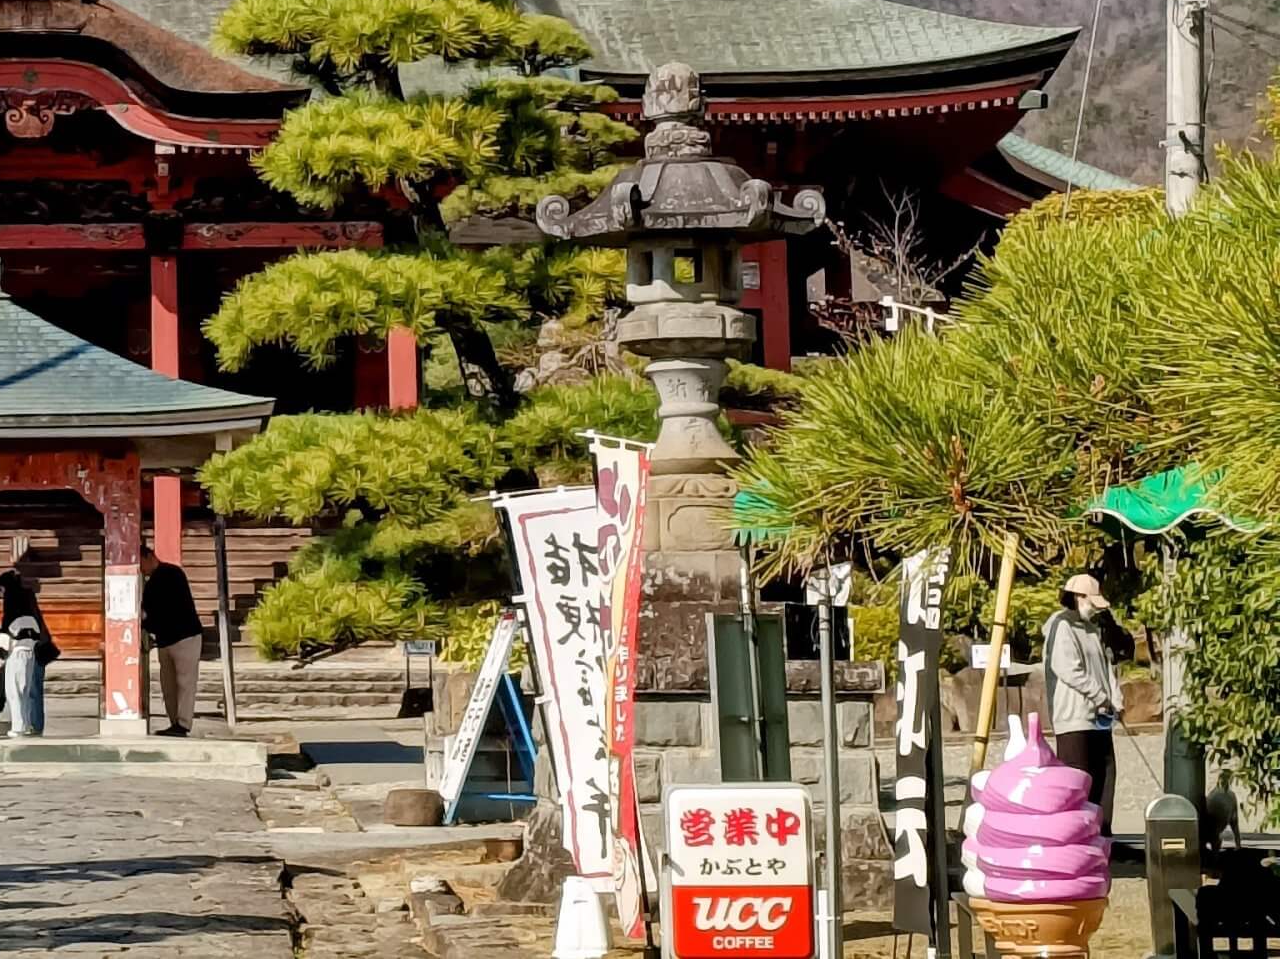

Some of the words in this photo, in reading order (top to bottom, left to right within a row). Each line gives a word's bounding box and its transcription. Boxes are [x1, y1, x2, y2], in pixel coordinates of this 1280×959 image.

[679, 807, 801, 847] 営業中
[699, 857, 787, 876] かぶとや
[692, 896, 793, 932] UCC
[712, 936, 775, 950] COFFEE
